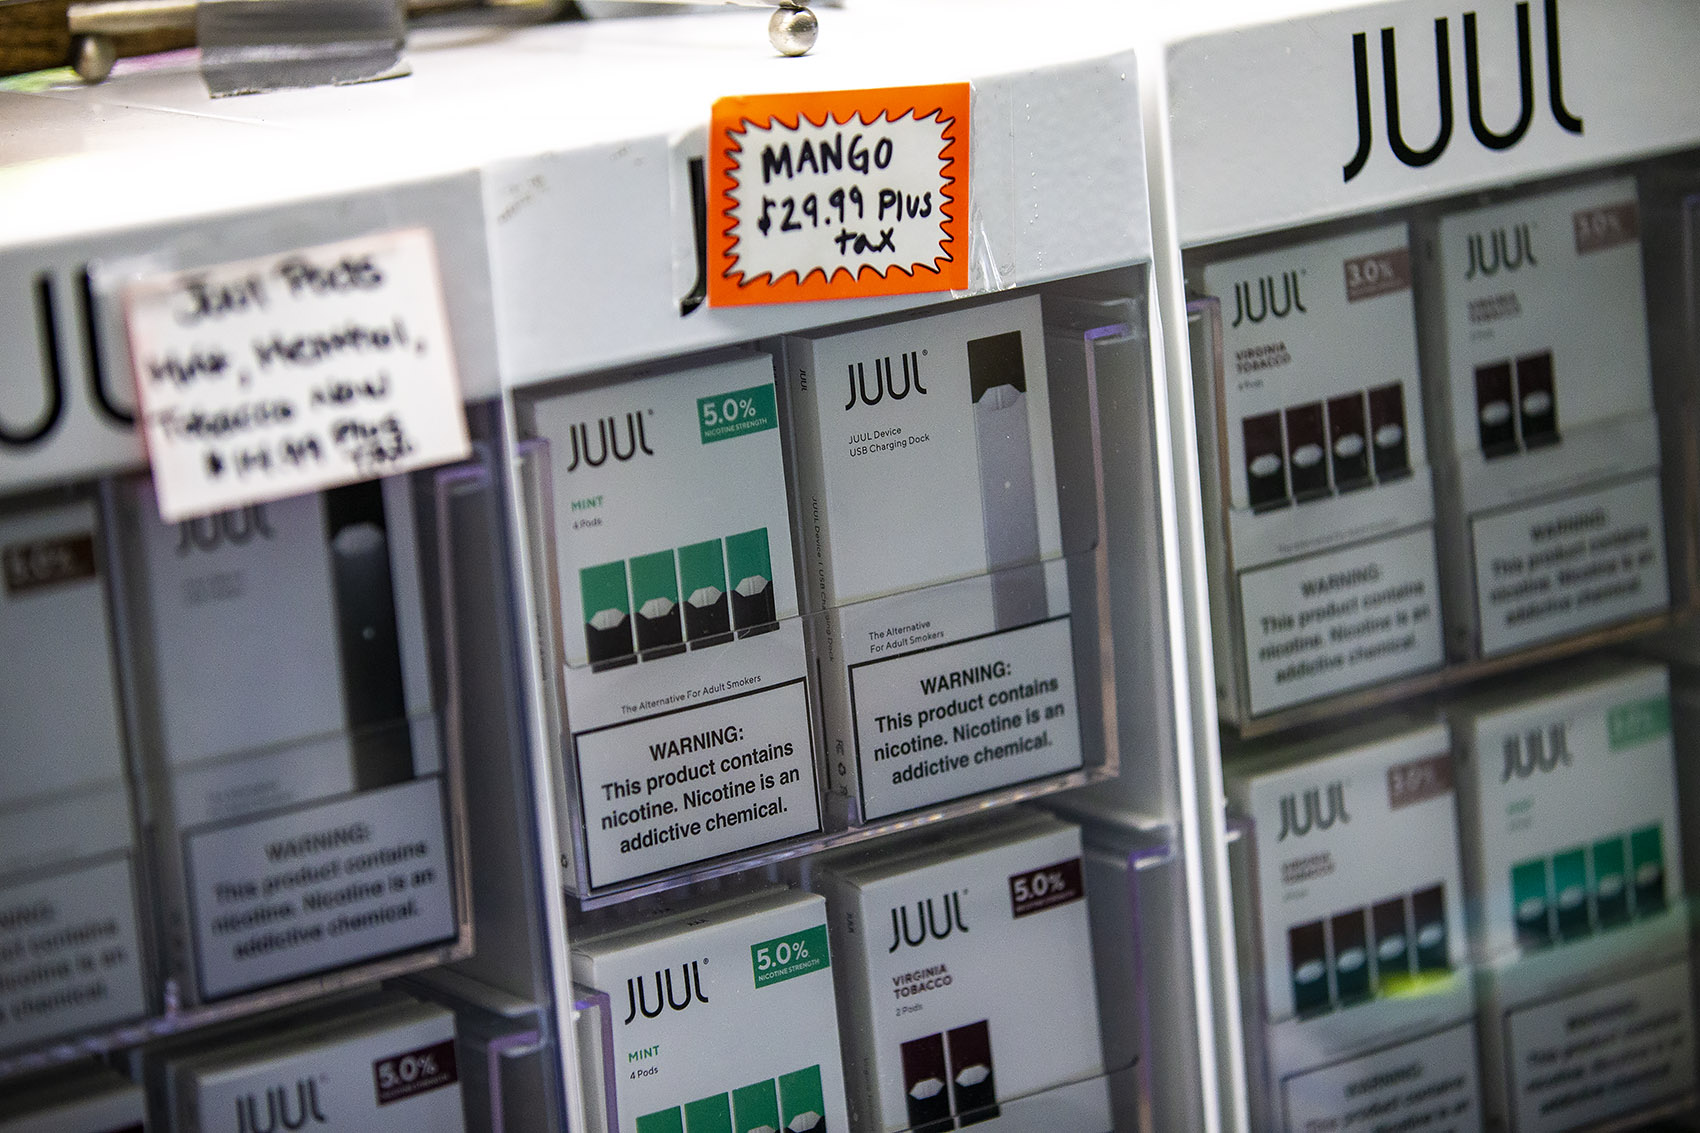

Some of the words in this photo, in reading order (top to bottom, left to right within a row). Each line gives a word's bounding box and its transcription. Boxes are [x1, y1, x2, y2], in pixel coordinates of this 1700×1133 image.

[1343, 0, 1584, 183] JUUL
[761, 132, 893, 184] MANGO
[758, 184, 864, 236] $29.99
[834, 227, 896, 255] tax
[1232, 270, 1307, 327] JUUL
[702, 397, 757, 427] 5.0%
[704, 424, 735, 438] NICOTINE
[735, 417, 768, 431] STRENGTH
[848, 432, 873, 444] JUUL
[874, 426, 902, 439] Device
[850, 446, 868, 457] USB
[869, 438, 907, 453] Charging
[908, 433, 930, 446] Dock
[571, 495, 603, 512] MINT
[580, 518, 602, 528] Pods
[1301, 562, 1381, 598] WARNING
[868, 631, 885, 641] The
[886, 620, 931, 637] Alternative
[870, 643, 884, 653] For
[885, 637, 908, 650] Adult
[909, 630, 945, 645] Smokers
[1258, 631, 1322, 662] nicotine
[920, 660, 1012, 695] WARNING:
[621, 705, 637, 715] The
[639, 693, 686, 711] Alternative
[687, 689, 701, 699] For
[702, 682, 725, 696] Adult
[726, 674, 762, 689] Smokers
[874, 713, 913, 734] This
[918, 694, 984, 728] product
[988, 677, 1059, 704] contains
[649, 725, 744, 761] WARNING:
[874, 733, 948, 761] nicotine.
[953, 711, 1022, 743] Nicotine
[1026, 706, 1041, 725] is
[1044, 702, 1065, 720] an
[601, 780, 641, 801] This
[646, 760, 716, 795] product
[720, 742, 794, 770] contains
[892, 752, 970, 785] addictive
[974, 730, 1053, 765] chemical.
[601, 801, 678, 830] nicotine.
[683, 778, 756, 810] Nicotine
[760, 773, 775, 791] is
[779, 768, 800, 786] an
[620, 820, 701, 854] addictive
[705, 796, 788, 832] chemical.
[1013, 872, 1067, 902] 5.0%
[757, 940, 809, 971] 5.0%
[758, 966, 788, 982] NICOTINE
[788, 957, 820, 973] STRENGTH
[892, 964, 947, 987] VIRGINIA
[893, 975, 953, 999] TOBACCO
[628, 1045, 660, 1063] MINT
[630, 1071, 636, 1080] 4
[637, 1066, 659, 1079] Pods
